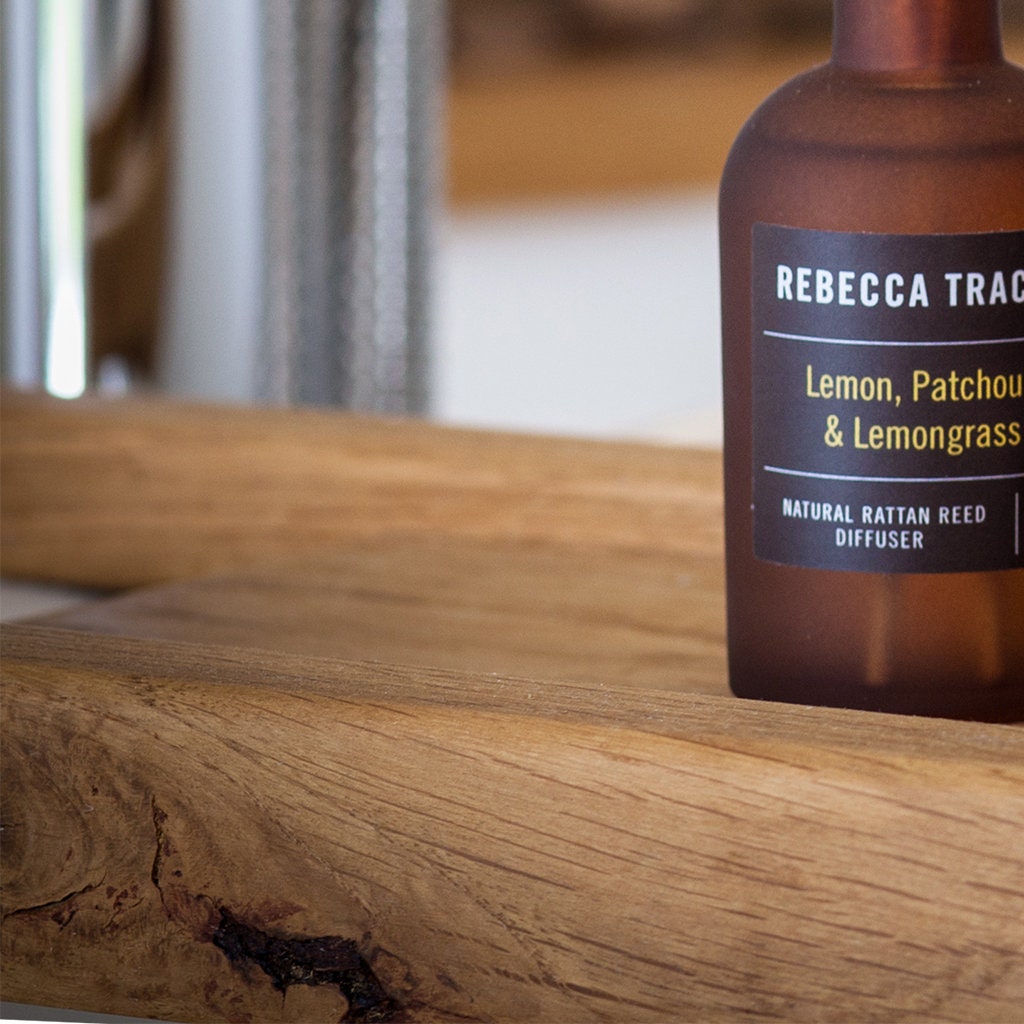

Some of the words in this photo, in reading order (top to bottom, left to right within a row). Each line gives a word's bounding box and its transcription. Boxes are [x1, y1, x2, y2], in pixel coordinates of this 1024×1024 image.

[776, 264, 929, 308] REBECCA
[806, 364, 902, 408] Lemon,
[824, 414, 844, 447] &
[854, 416, 1022, 456] Lemongrass
[782, 496, 854, 524] NATURAL
[862, 505, 930, 525] RATTAN
[939, 504, 986, 524] REED
[835, 527, 924, 549] DIFFUSER
